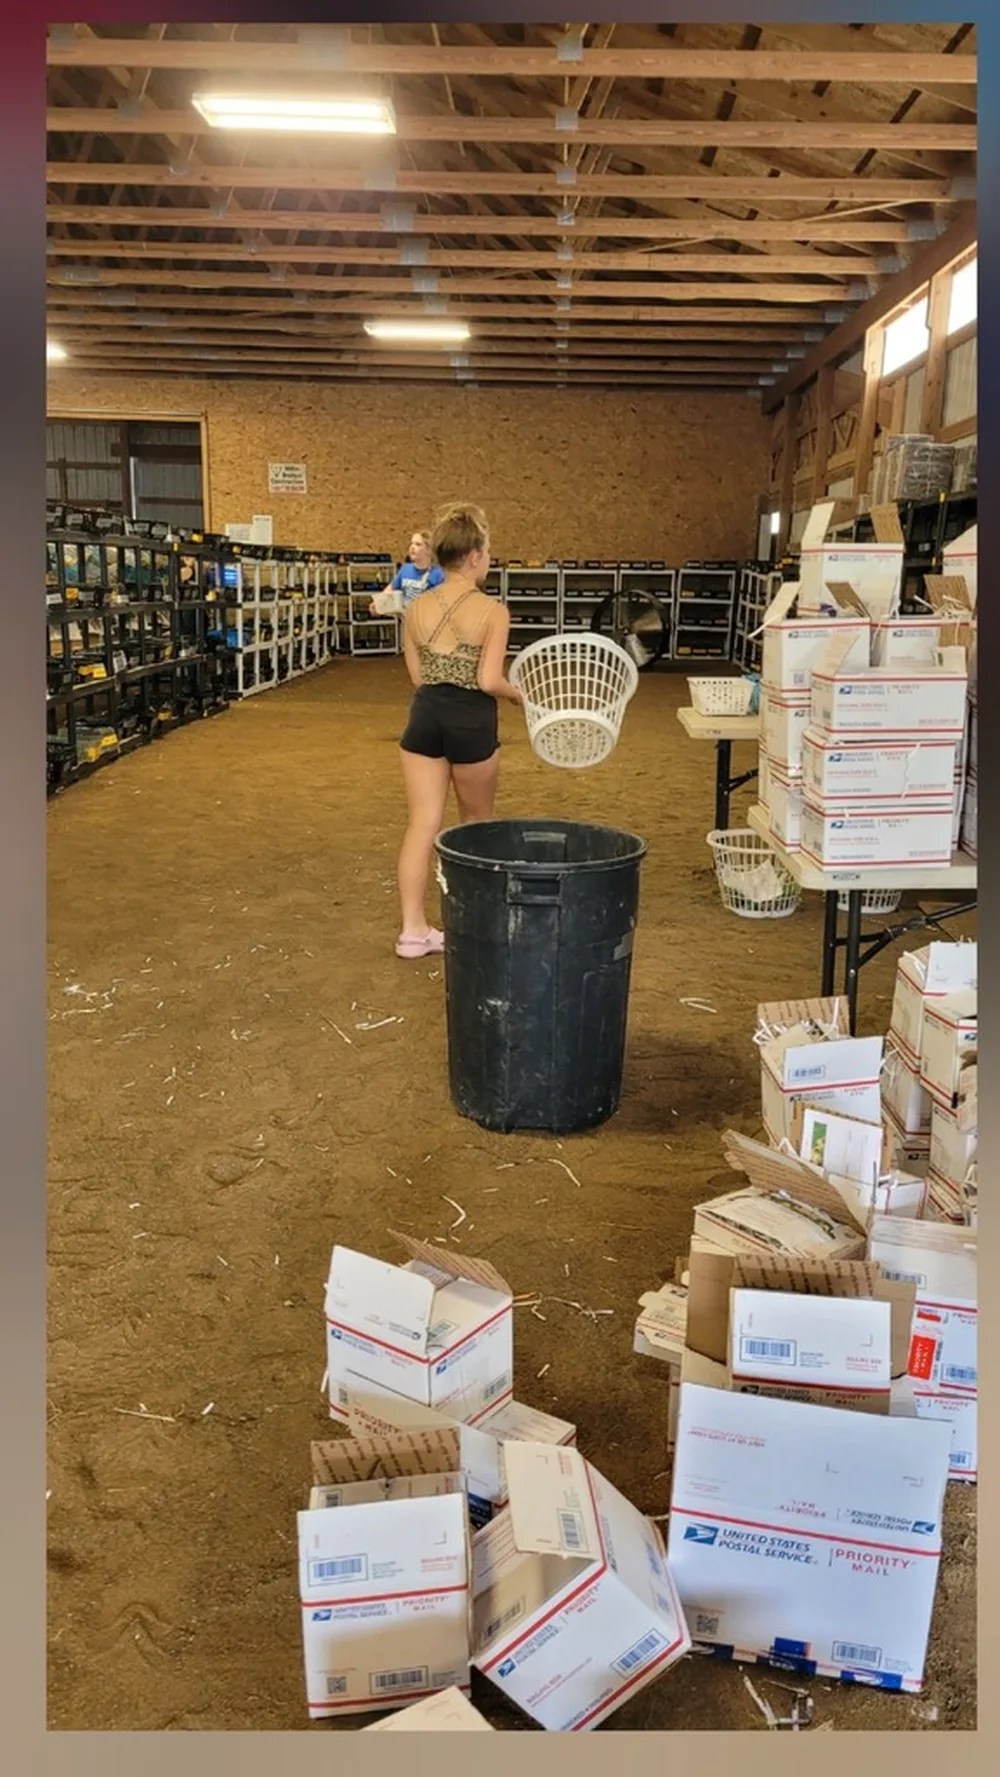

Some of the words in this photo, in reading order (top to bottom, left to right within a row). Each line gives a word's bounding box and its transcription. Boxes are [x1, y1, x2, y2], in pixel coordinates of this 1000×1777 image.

[354, 1408, 400, 1433] PRIORITY
[718, 1540, 761, 1556] POSTAL
[723, 1529, 768, 1545] UNITED
[769, 1536, 811, 1552] STATES
[835, 1549, 911, 1569] PRIORITY
[852, 1563, 890, 1577] MAIL
[403, 1597, 446, 1607] PRIORITY
[564, 1585, 599, 1615] PRIORITY
[577, 1597, 597, 1614] MAIL
